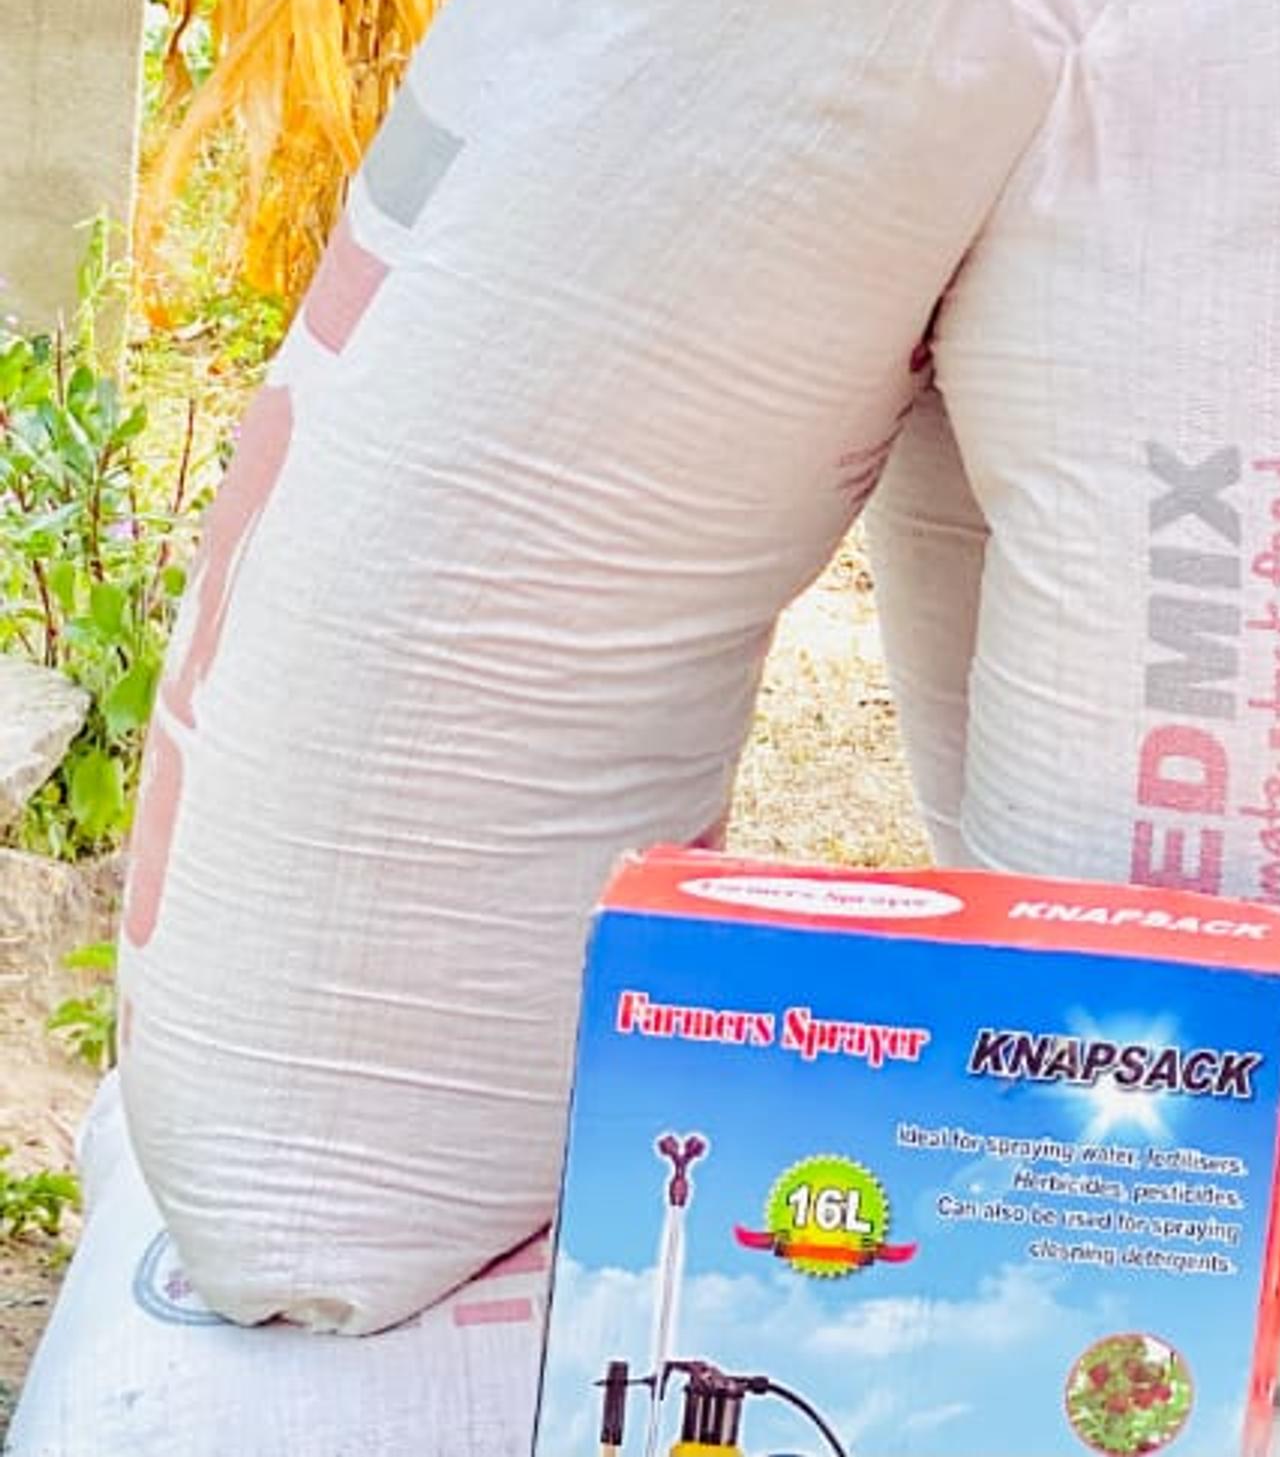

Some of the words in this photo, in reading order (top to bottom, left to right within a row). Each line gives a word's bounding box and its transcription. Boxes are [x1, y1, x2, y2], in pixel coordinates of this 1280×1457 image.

[1007, 901, 1271, 940] KNAPSACK
[617, 991, 774, 1043] Farmers
[782, 1007, 931, 1068] Sprayer
[968, 1029, 1261, 1098] KNAPSACK
[898, 1123, 949, 1148] Ideal
[953, 1128, 979, 1150] for
[985, 1135, 1075, 1165] spraying
[787, 1184, 874, 1234] 16L
[936, 1194, 977, 1217] Can
[982, 1200, 1025, 1223] also
[1030, 1205, 1058, 1226] be
[1060, 1208, 1113, 1230] used
[1117, 1212, 1146, 1233] for
[1150, 1218, 1241, 1244] spraying
[1028, 1240, 1117, 1266] cleaning
